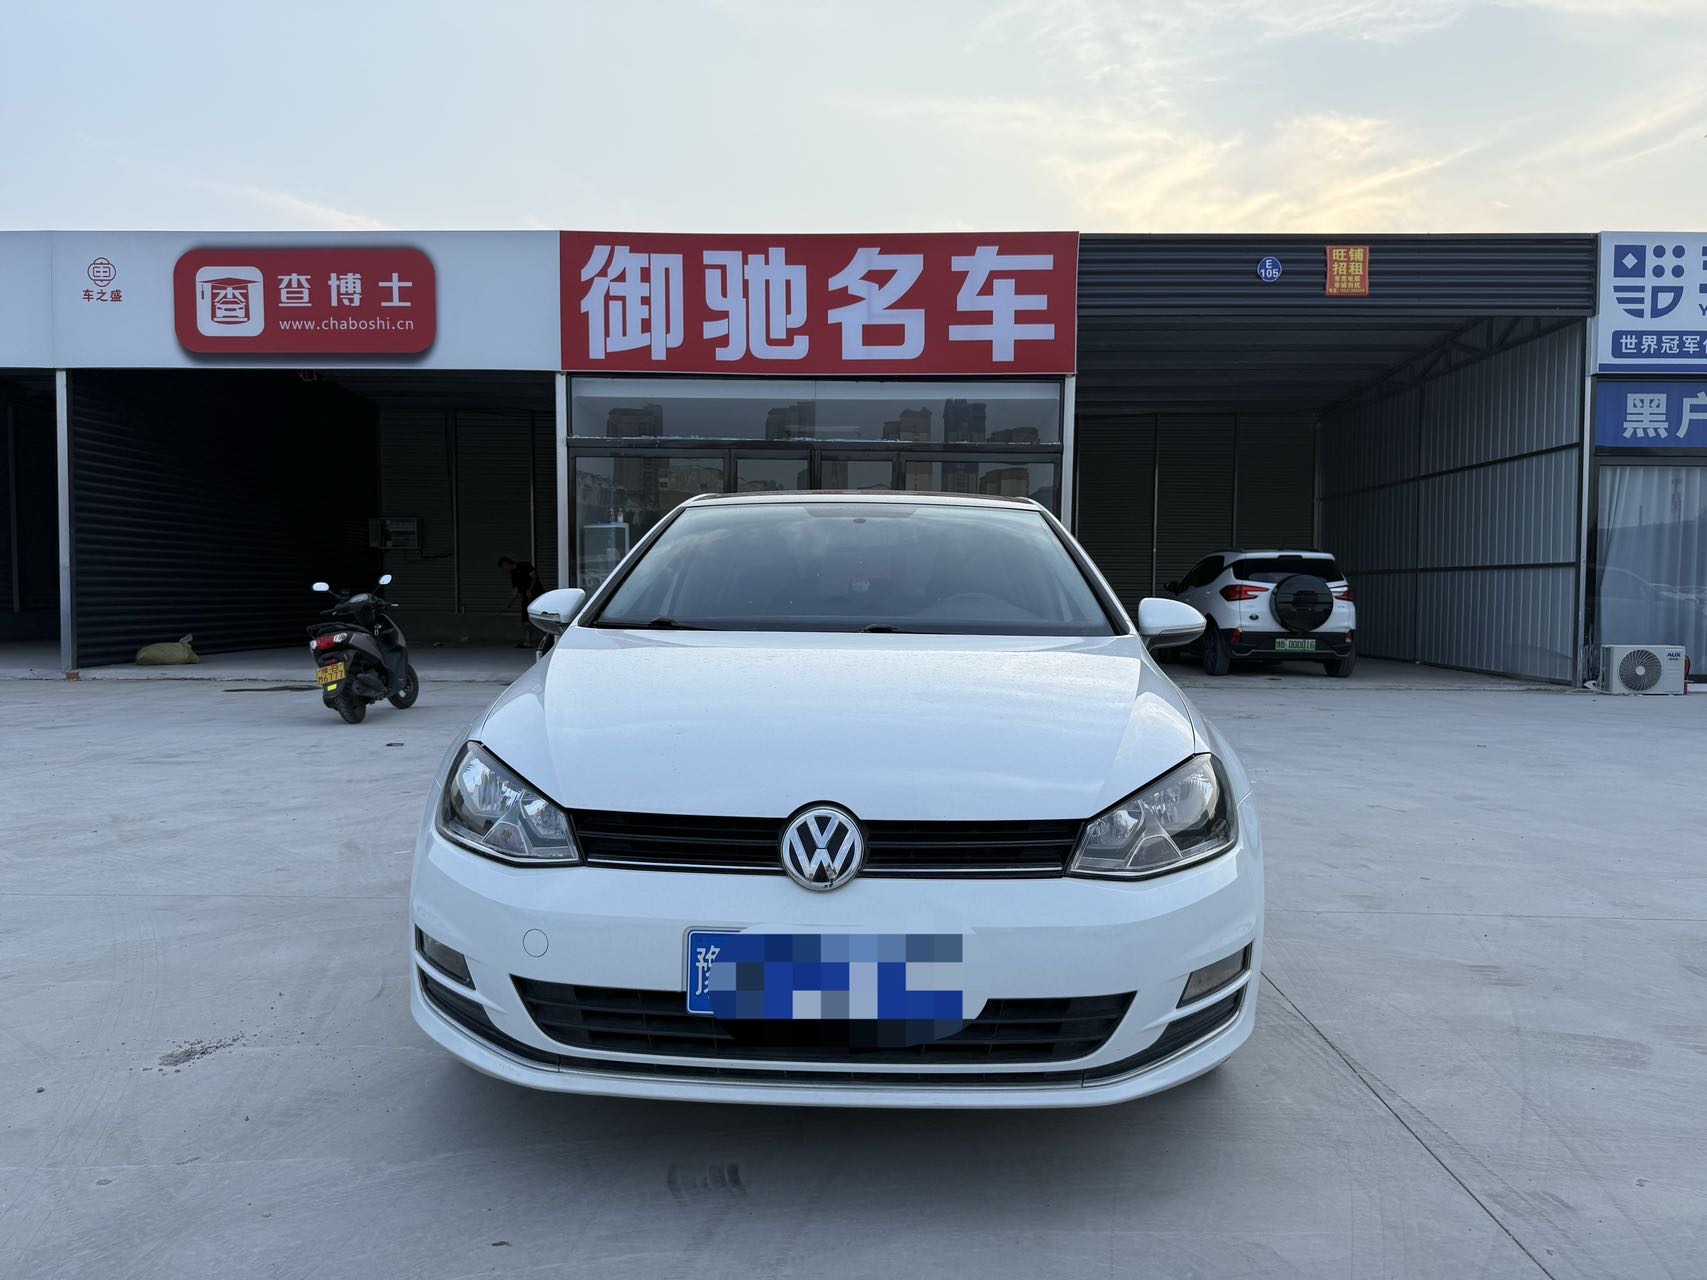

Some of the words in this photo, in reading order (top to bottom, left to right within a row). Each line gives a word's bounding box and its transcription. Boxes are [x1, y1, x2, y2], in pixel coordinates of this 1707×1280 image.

[1332, 248, 1364, 261] 旺铺
[1265, 259, 1273, 269] E
[1332, 262, 1364, 275] 招租
[1259, 269, 1279, 278] 105
[82, 289, 122, 302] 车之盛
[278, 273, 412, 307] 查博士
[579, 244, 1055, 362] 御驰名车
[279, 316, 414, 330] www.chaboshi.cn
[1620, 334, 1707, 354] 世界冠军
